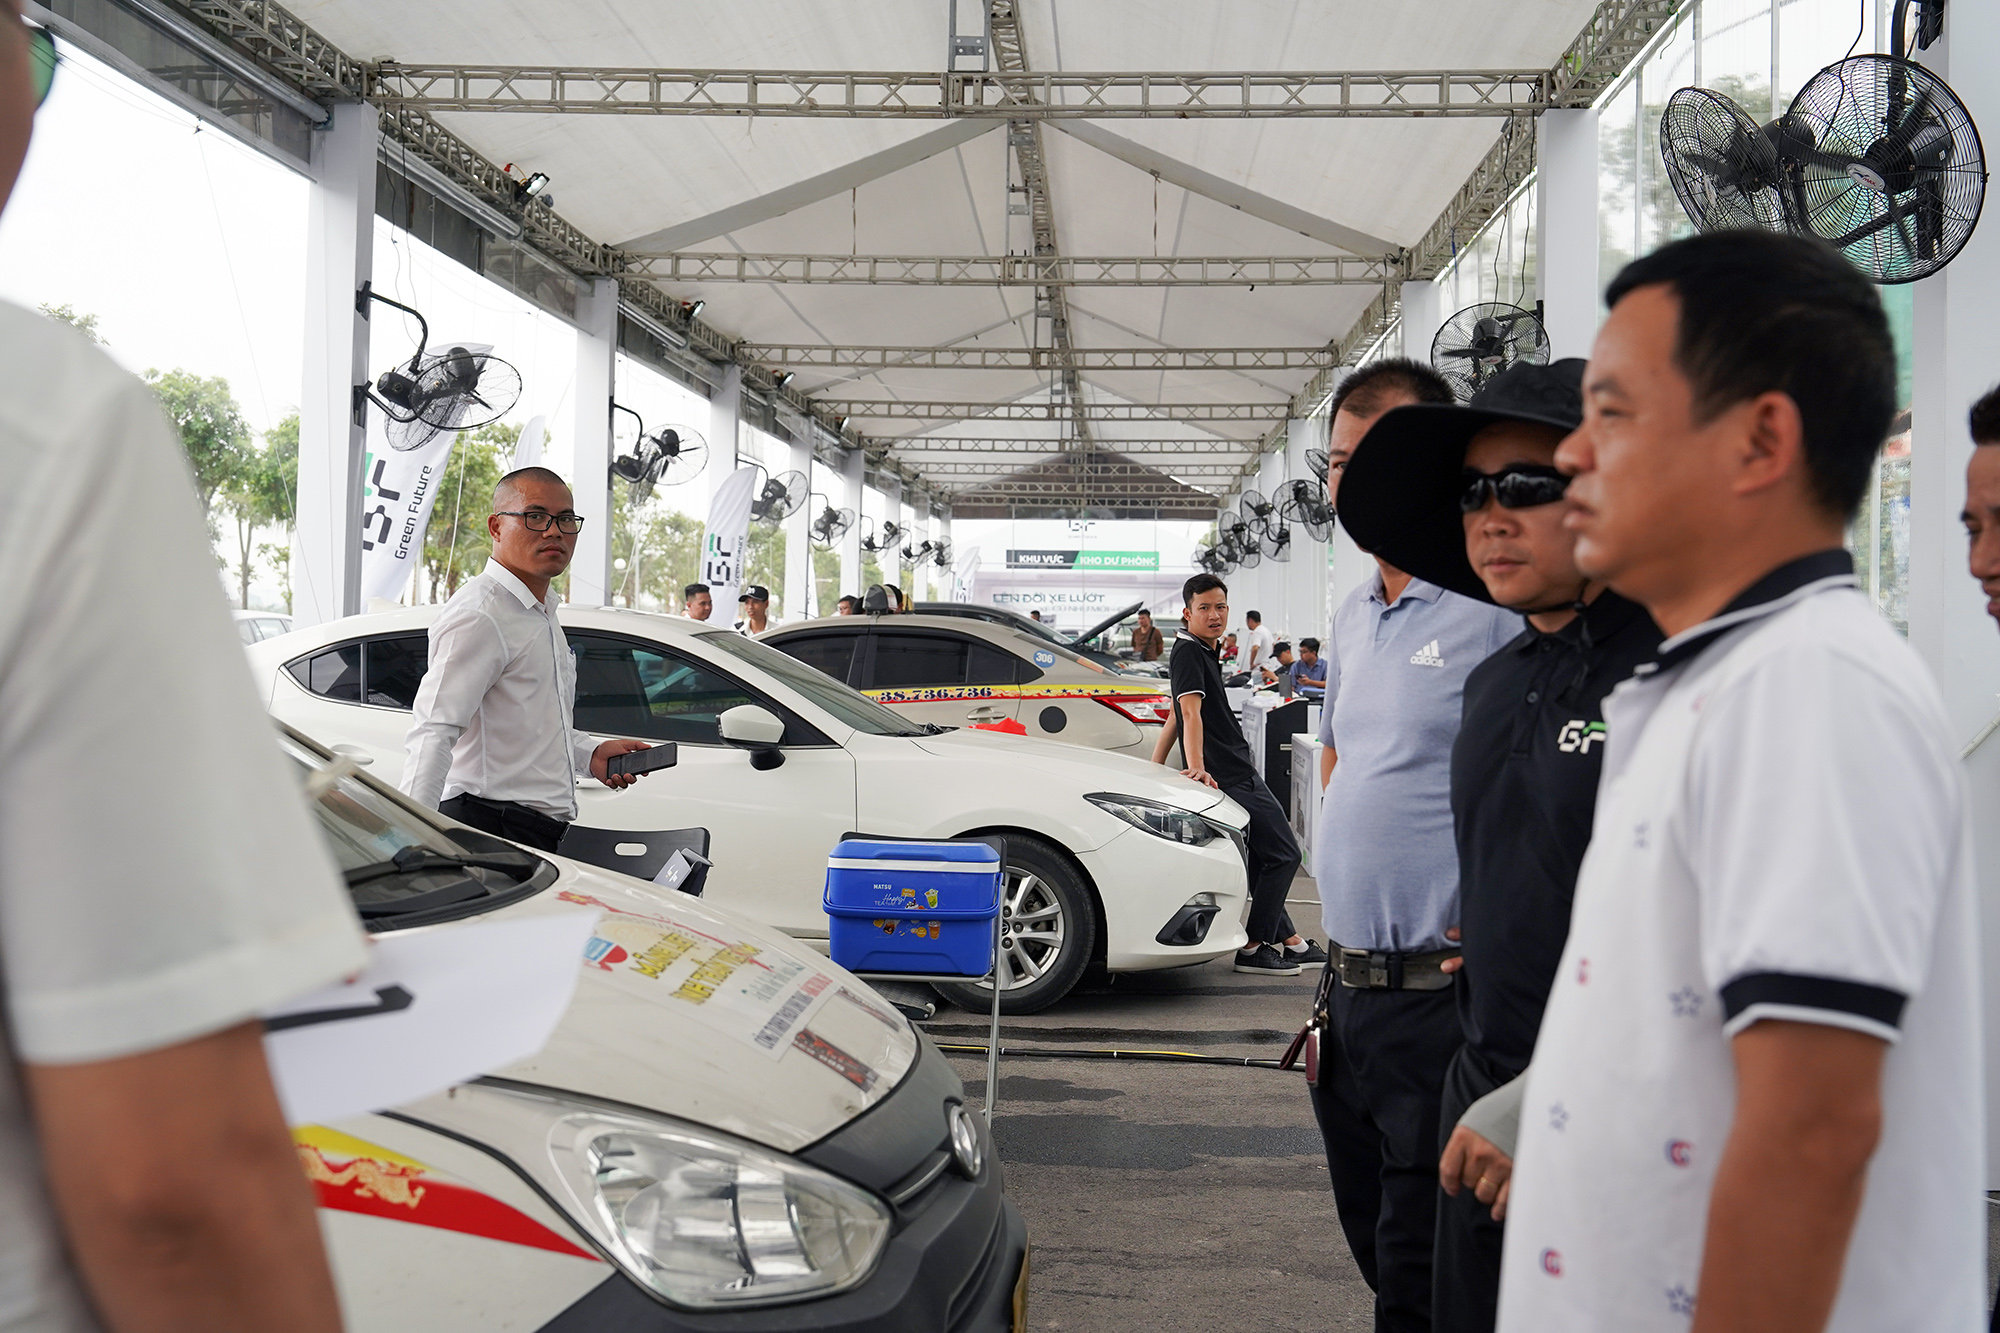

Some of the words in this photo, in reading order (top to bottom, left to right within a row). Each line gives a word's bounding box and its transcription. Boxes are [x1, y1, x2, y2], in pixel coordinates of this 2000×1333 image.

[394, 518, 417, 560] Green
[408, 465, 433, 514] Future
[1019, 555, 1040, 563] KHU
[1080, 556, 1102, 565] KHO
[1410, 655, 1444, 668] adidas
[880, 686, 993, 702] 38.736.736
